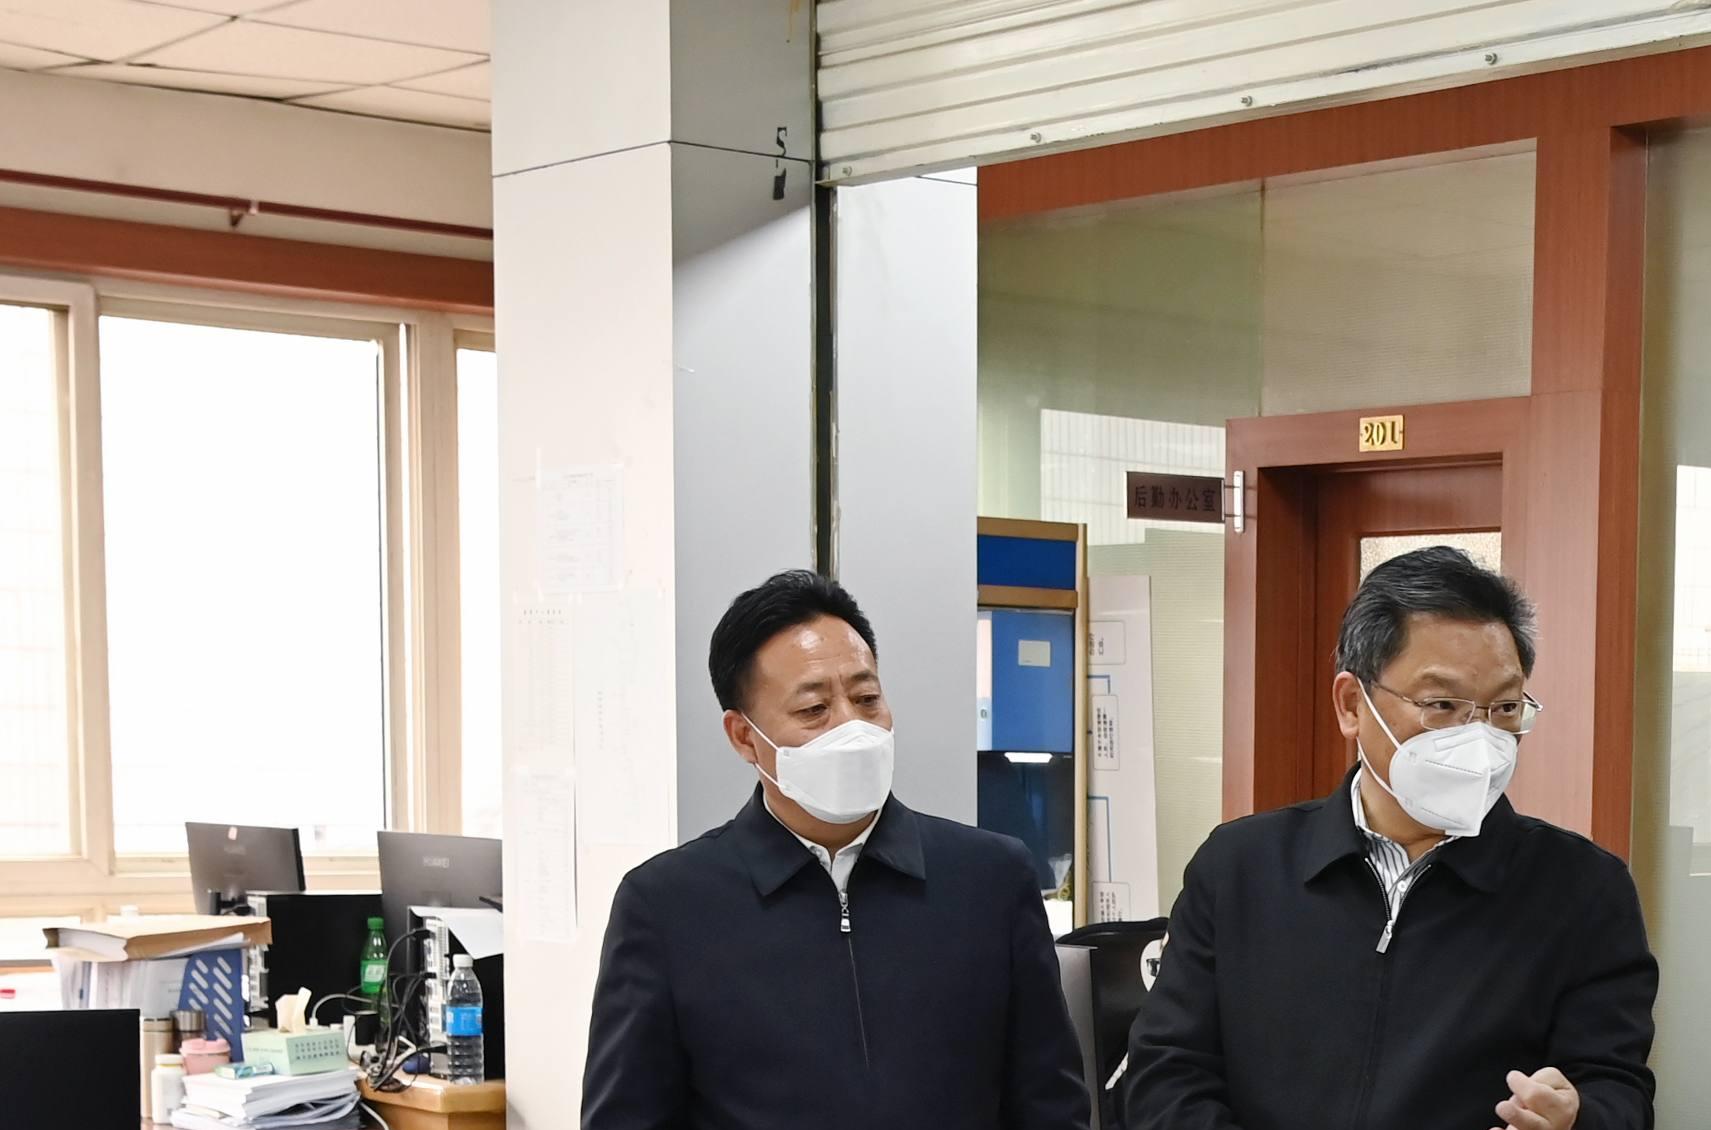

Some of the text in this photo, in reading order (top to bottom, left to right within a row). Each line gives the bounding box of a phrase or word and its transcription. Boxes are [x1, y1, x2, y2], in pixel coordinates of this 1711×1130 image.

[1363, 421, 1398, 446] 201
[1134, 485, 1217, 512] 后勤办公室
